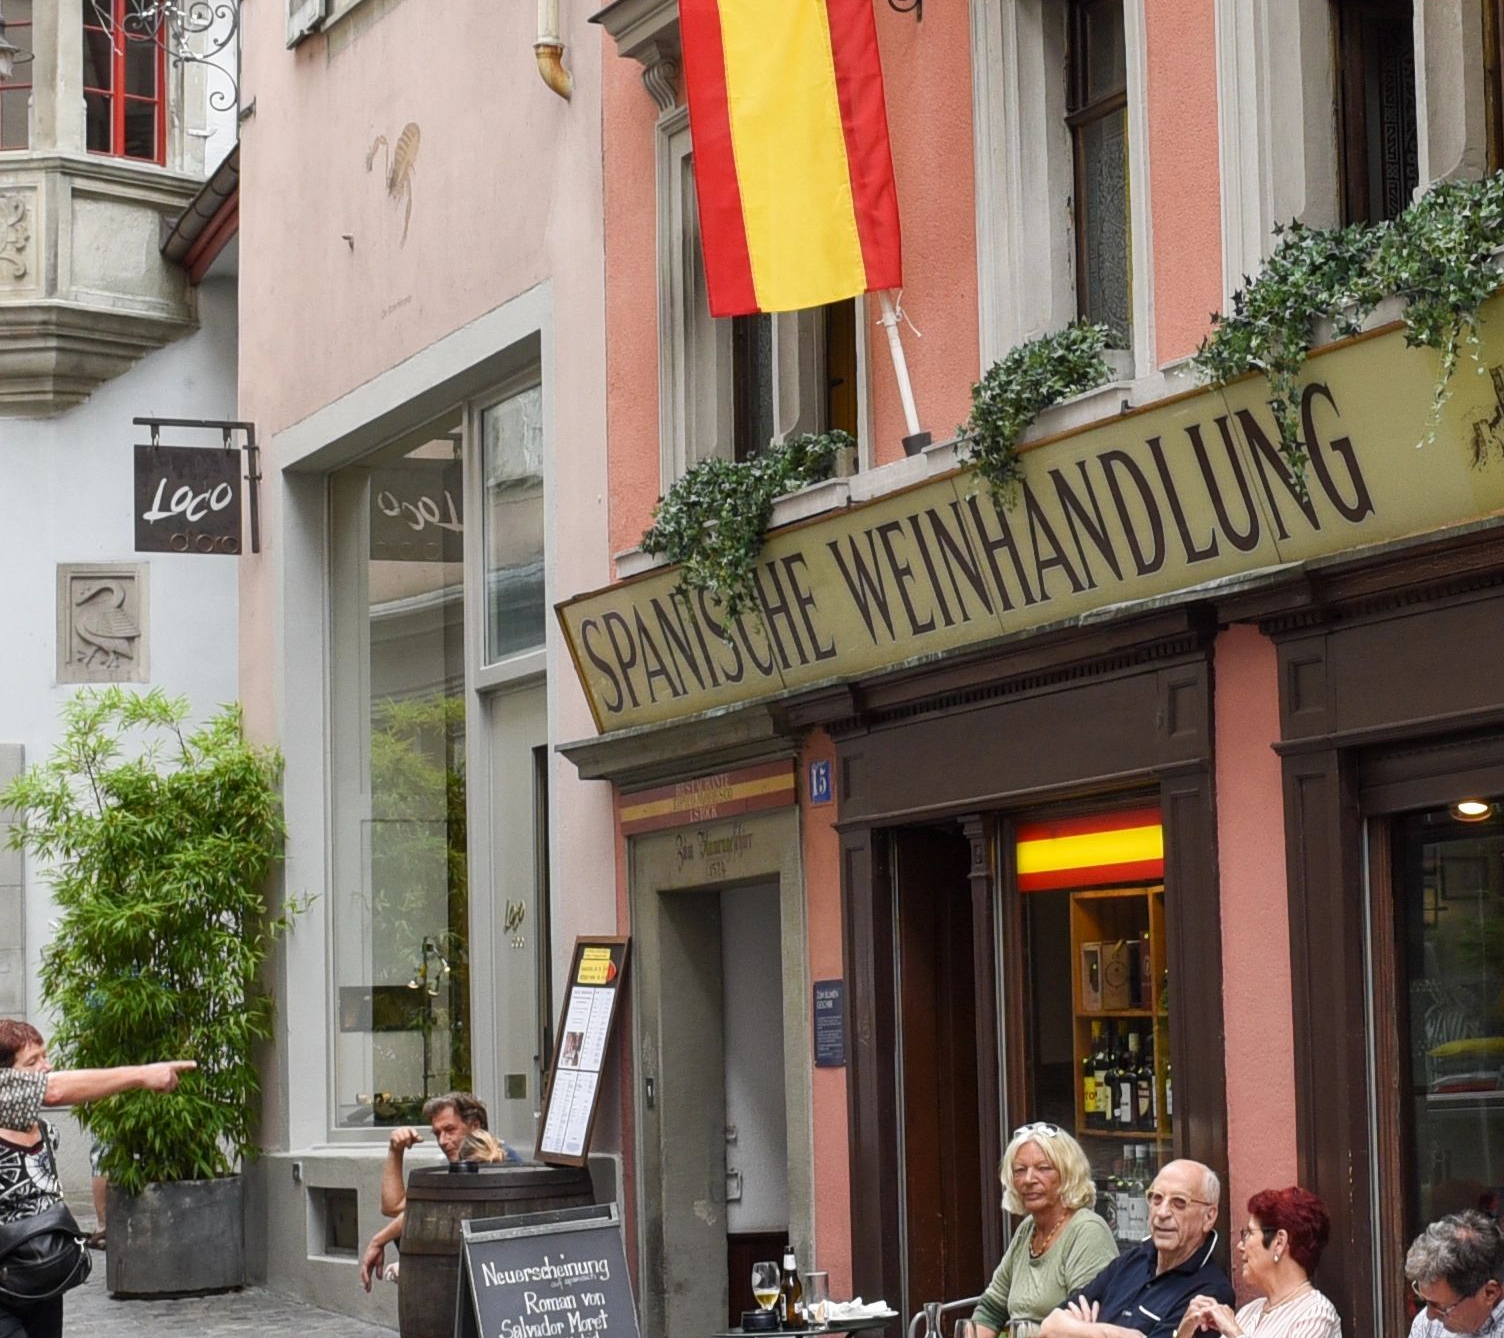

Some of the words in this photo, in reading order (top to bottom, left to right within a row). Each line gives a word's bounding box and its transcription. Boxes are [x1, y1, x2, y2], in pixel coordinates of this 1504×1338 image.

[580, 552, 837, 714] SPANISCHE
[827, 383, 1376, 644] WEINHANDLUNG
[812, 767, 826, 798] 15
[482, 1253, 609, 1287] Neuerscheinung
[524, 1291, 577, 1315] Roman
[581, 1292, 606, 1307] von
[567, 1309, 608, 1333] Moret
